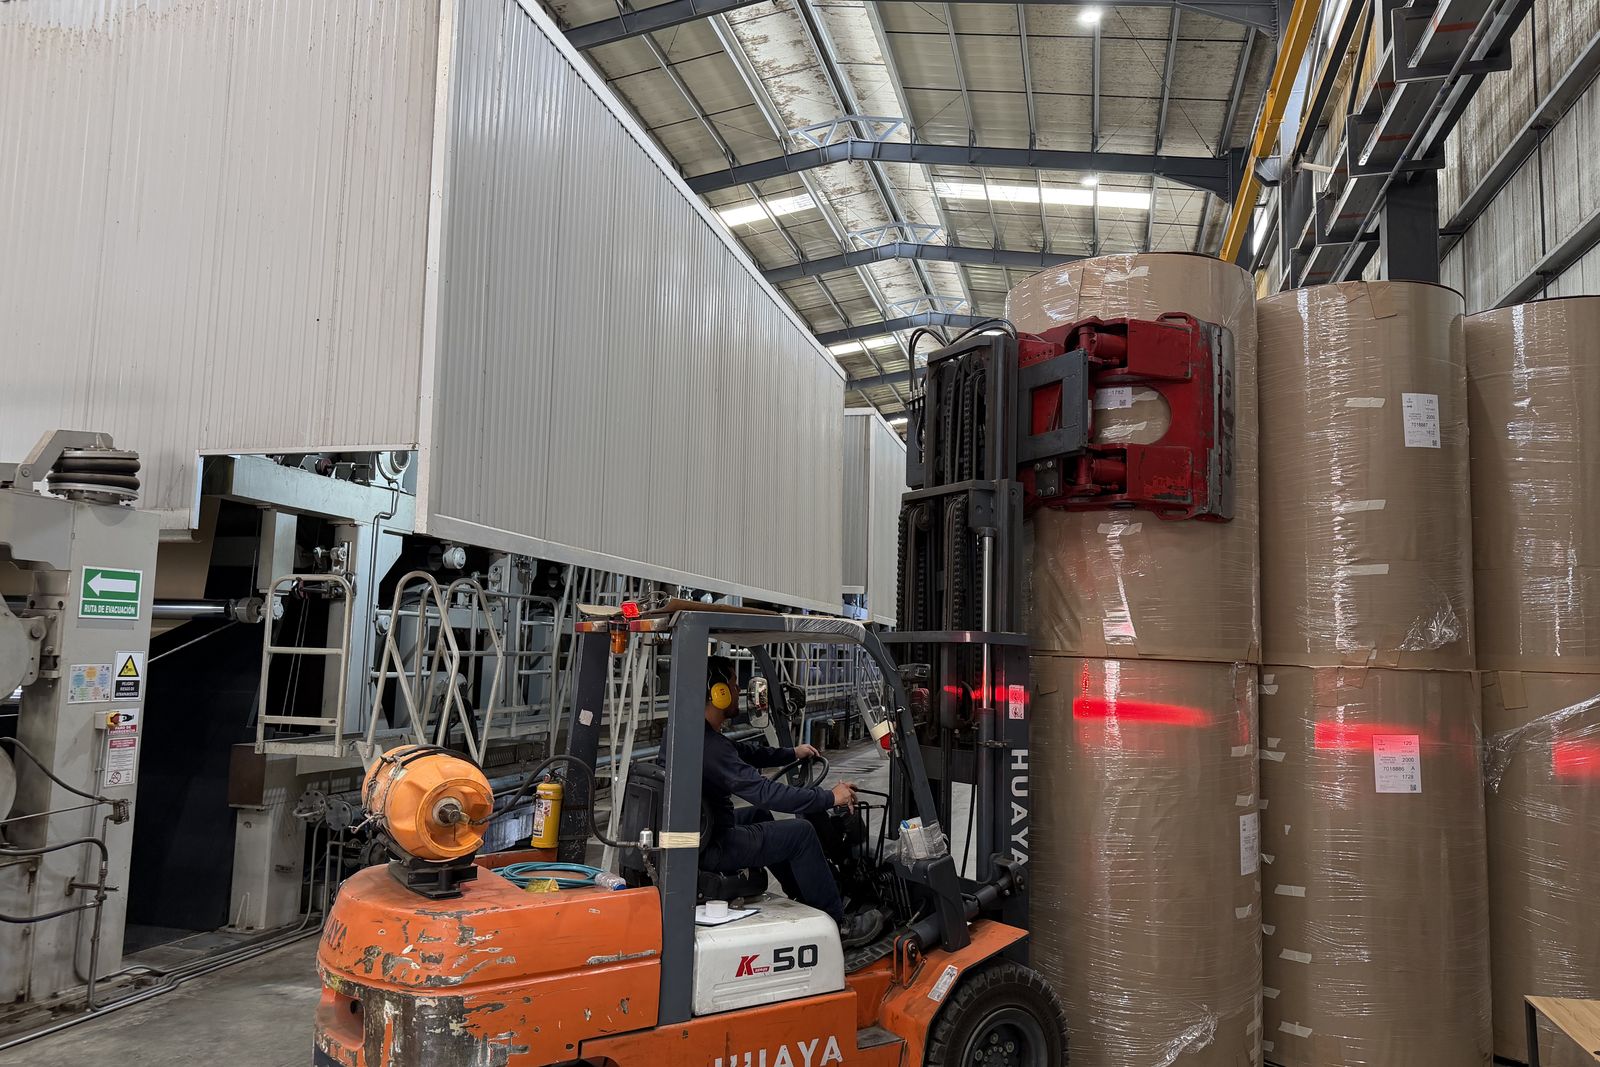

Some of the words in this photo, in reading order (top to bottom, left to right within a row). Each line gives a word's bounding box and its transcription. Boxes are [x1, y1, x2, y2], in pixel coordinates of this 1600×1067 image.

[84, 604, 97, 613] RUTA
[98, 605, 105, 613] DE
[105, 604, 136, 615] EVACUACIÓN
[1011, 749, 1029, 866] HUAYA
[773, 944, 818, 973] 50
